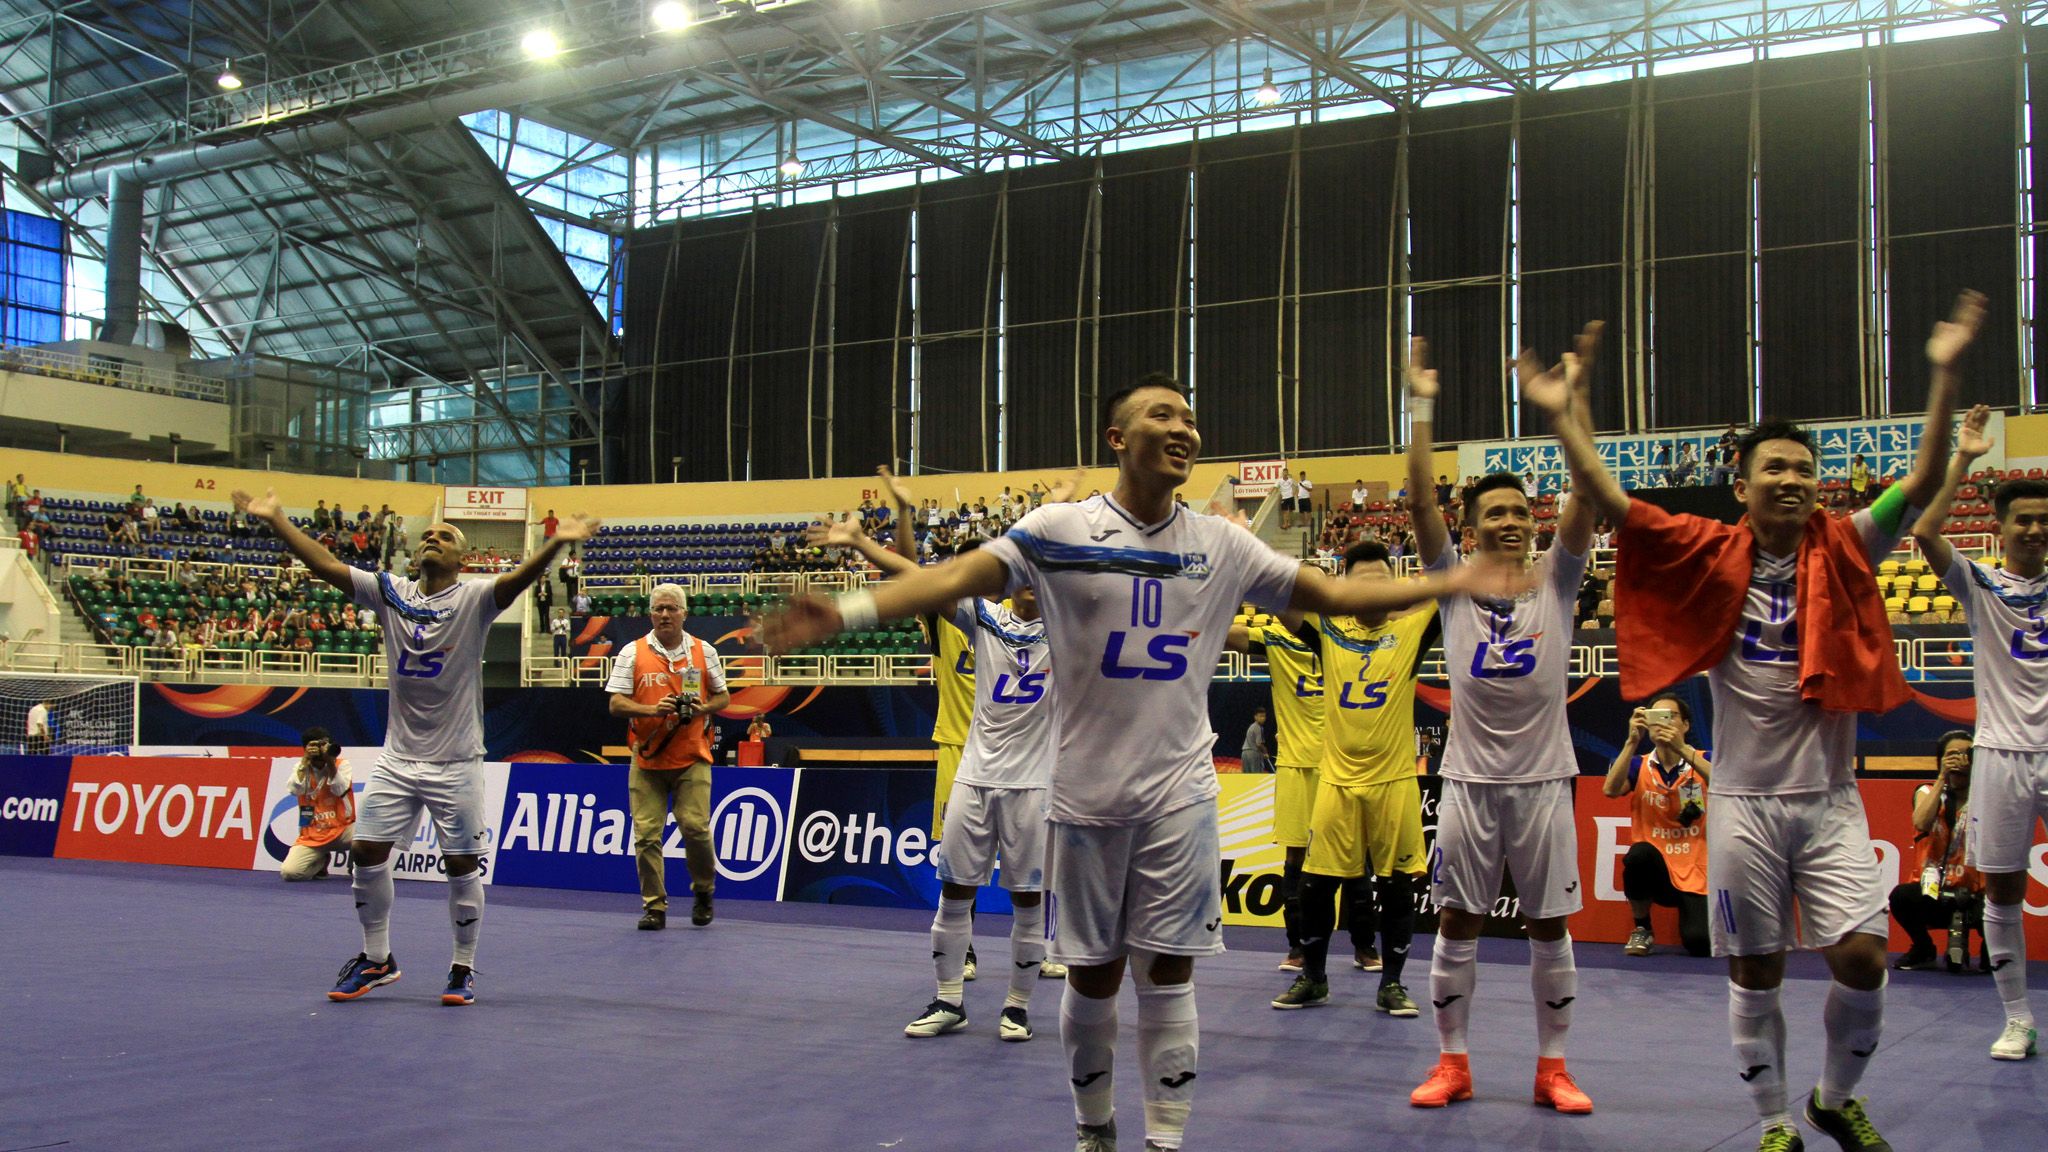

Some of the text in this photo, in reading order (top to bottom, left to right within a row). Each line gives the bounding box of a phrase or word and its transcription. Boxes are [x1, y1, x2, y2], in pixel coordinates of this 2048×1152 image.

[195, 478, 215, 490] A2
[1243, 465, 1282, 480] EXIT
[467, 490, 505, 504] EXIT
[862, 488, 878, 500] B1
[1131, 576, 1162, 628] 10
[2028, 605, 2045, 631] 5
[413, 624, 425, 650] 6
[397, 650, 444, 678] LS
[1017, 648, 1029, 677] 9
[1101, 631, 1190, 681] LS
[1358, 655, 1371, 681] 2
[1471, 639, 1536, 678] LS
[992, 673, 1045, 704] LS
[1339, 681, 1389, 709] LS
[72, 782, 253, 841] TOYOTA
[1652, 825, 1700, 839] PHOTO
[1665, 842, 1690, 855] 058
